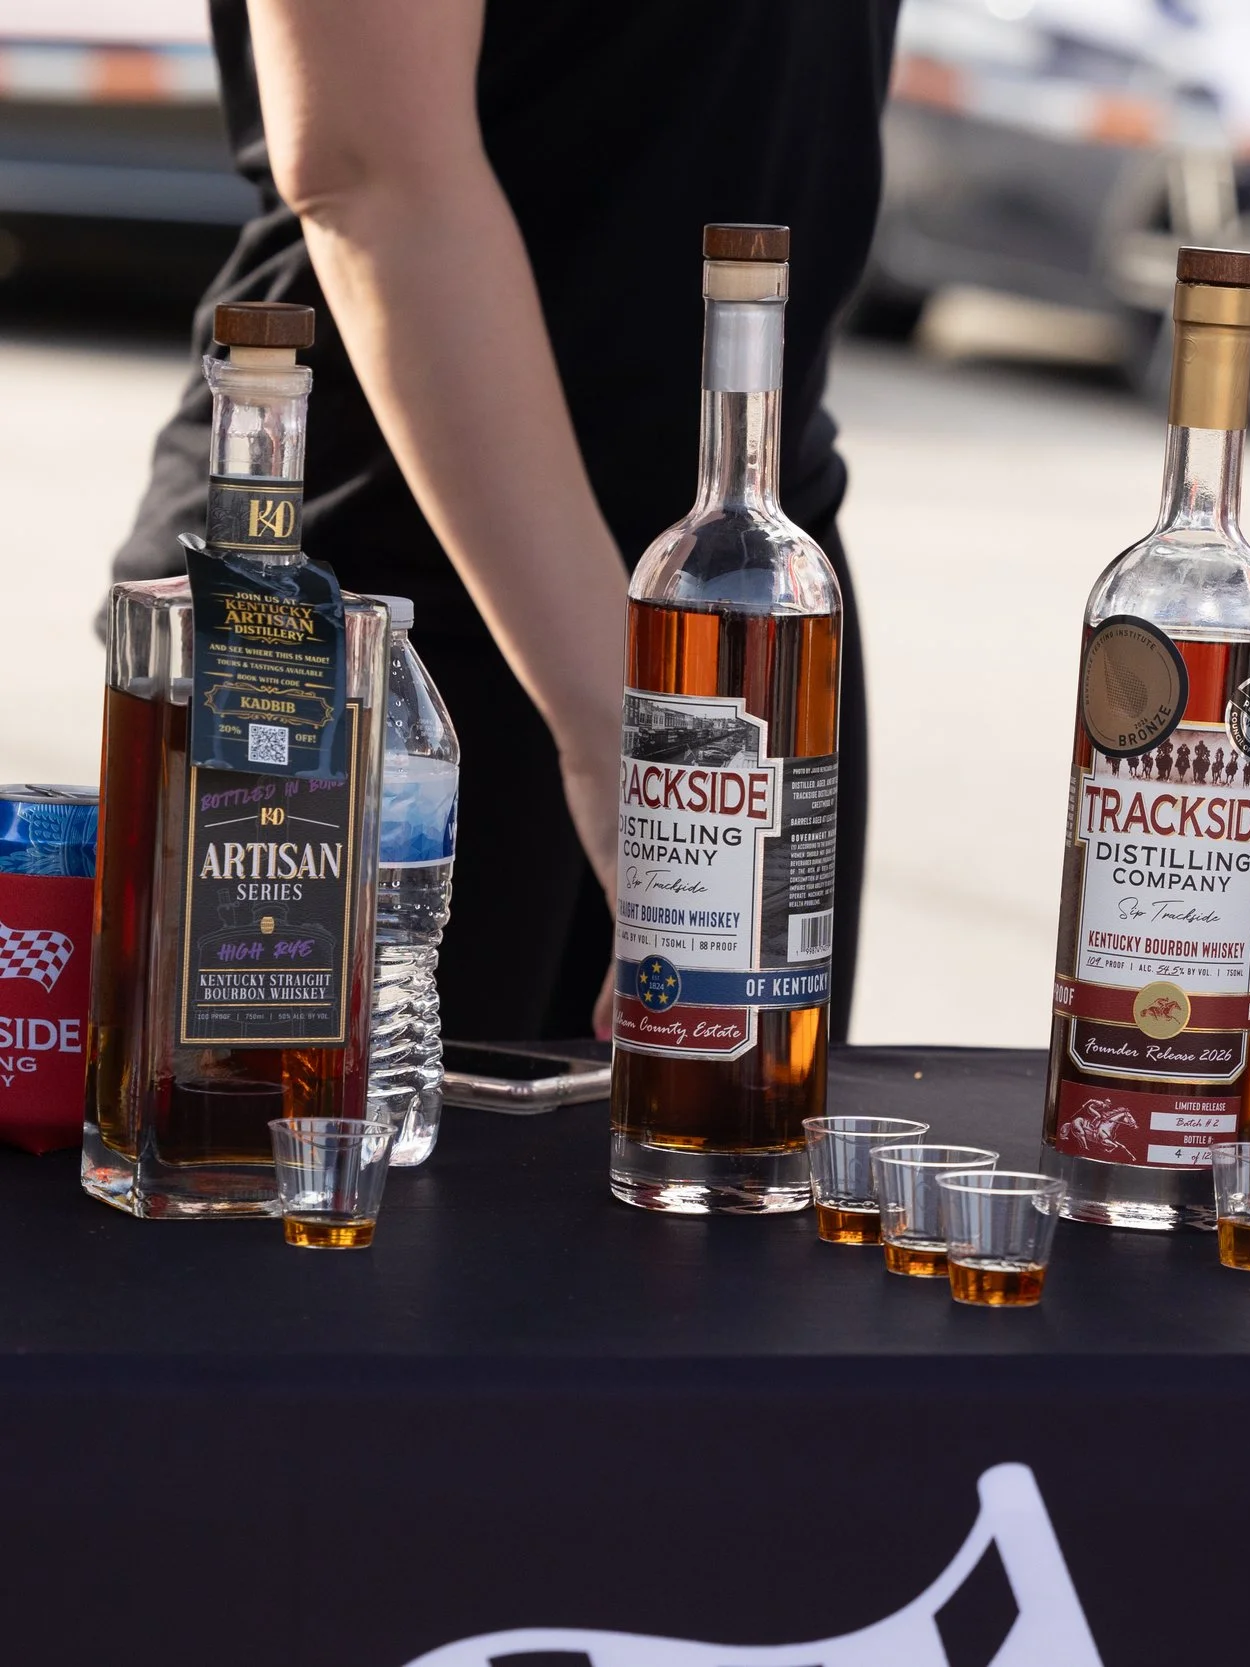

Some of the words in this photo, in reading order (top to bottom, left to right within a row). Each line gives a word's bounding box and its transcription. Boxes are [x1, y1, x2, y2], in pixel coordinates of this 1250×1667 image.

[225, 599, 312, 619] KENTUCKY
[235, 592, 261, 601] JOIN
[264, 594, 280, 604] US
[283, 598, 297, 606] AT
[224, 611, 314, 634] ARTISAN
[234, 625, 305, 642] DISTILLERY
[1116, 629, 1157, 651] INSTITUTE
[209, 643, 227, 652] AND
[228, 646, 244, 654] SEE
[245, 647, 273, 658] WHERE
[275, 651, 294, 660] THIS
[295, 654, 303, 662] IS
[217, 658, 241, 668] TOURS
[242, 661, 248, 669] &
[250, 662, 284, 673] TASTINGS
[285, 666, 324, 678] AVAILABLE
[236, 673, 257, 682] BOOK
[259, 676, 279, 685] WITH
[280, 679, 300, 687] CODE
[240, 696, 297, 714] KADBIB
[219, 724, 242, 735] 20%
[295, 733, 317, 744] OFF!
[1118, 704, 1172, 747] BRONZE
[1231, 711, 1245, 745] COUNCIL
[200, 842, 343, 880] ARTISAN
[623, 839, 718, 866] COMPANY
[1096, 841, 1250, 873] DISTILLING
[645, 869, 708, 893] Trackside
[1113, 867, 1232, 893] COMPANY
[236, 883, 303, 901] SERIES
[641, 904, 685, 926] BOURBON
[689, 910, 741, 928] WHISKEY
[1118, 896, 1146, 920] Sip
[1151, 900, 1221, 923] Trackside
[217, 942, 264, 962] HIGH
[273, 939, 315, 959] RYE
[661, 937, 687, 949] 750ML
[699, 940, 708, 951] 88
[710, 941, 738, 952] PROOF
[1088, 930, 1142, 952] KENTUCKY
[1144, 938, 1199, 958] BOURBON
[1202, 942, 1245, 959] WHISKEY
[1105, 960, 1125, 969] PROOF
[1139, 964, 1154, 973] ALC.
[1187, 968, 1195, 976] BY
[1198, 969, 1212, 977] VOL.
[1226, 969, 1244, 977] 750ML
[200, 974, 266, 986] KENTUCKY
[269, 973, 332, 986] STRAIGHT
[649, 982, 665, 991] 1824
[746, 978, 765, 997] OF
[772, 973, 829, 997] KENTUCKY
[204, 987, 266, 1000] BOURBON
[270, 987, 327, 1000] WHISKEY
[640, 1016, 688, 1044] County
[693, 1021, 742, 1038] Estate
[1085, 1037, 1139, 1057] Founder
[1146, 1045, 1196, 1062] Release
[1199, 1049, 1232, 1062] 2026
[1175, 1101, 1201, 1112] LIMITED
[1201, 1102, 1227, 1112] RELEASE
[1176, 1117, 1202, 1128] Batch
[1183, 1135, 1206, 1144] BOTTLE
